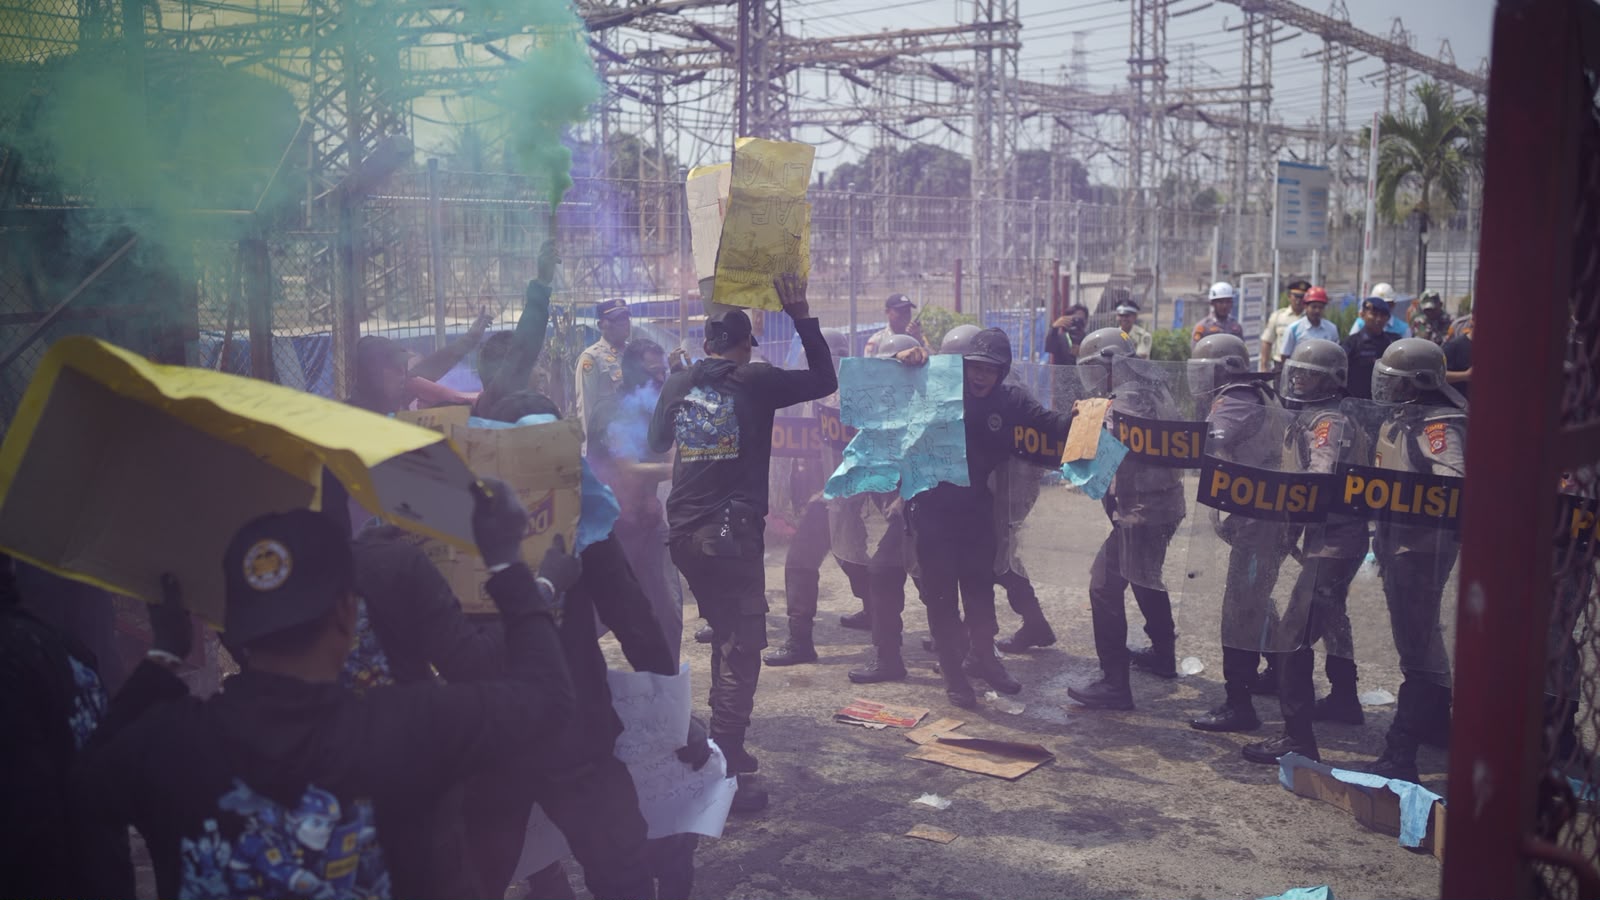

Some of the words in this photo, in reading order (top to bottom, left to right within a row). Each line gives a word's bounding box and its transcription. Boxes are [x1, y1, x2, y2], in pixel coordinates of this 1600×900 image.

[772, 425, 821, 449] OLIS
[821, 413, 857, 443] POL
[1119, 422, 1200, 459] POLISI
[1210, 470, 1319, 513] POLISI
[1344, 475, 1459, 518] POLISI
[1571, 508, 1600, 542] P
